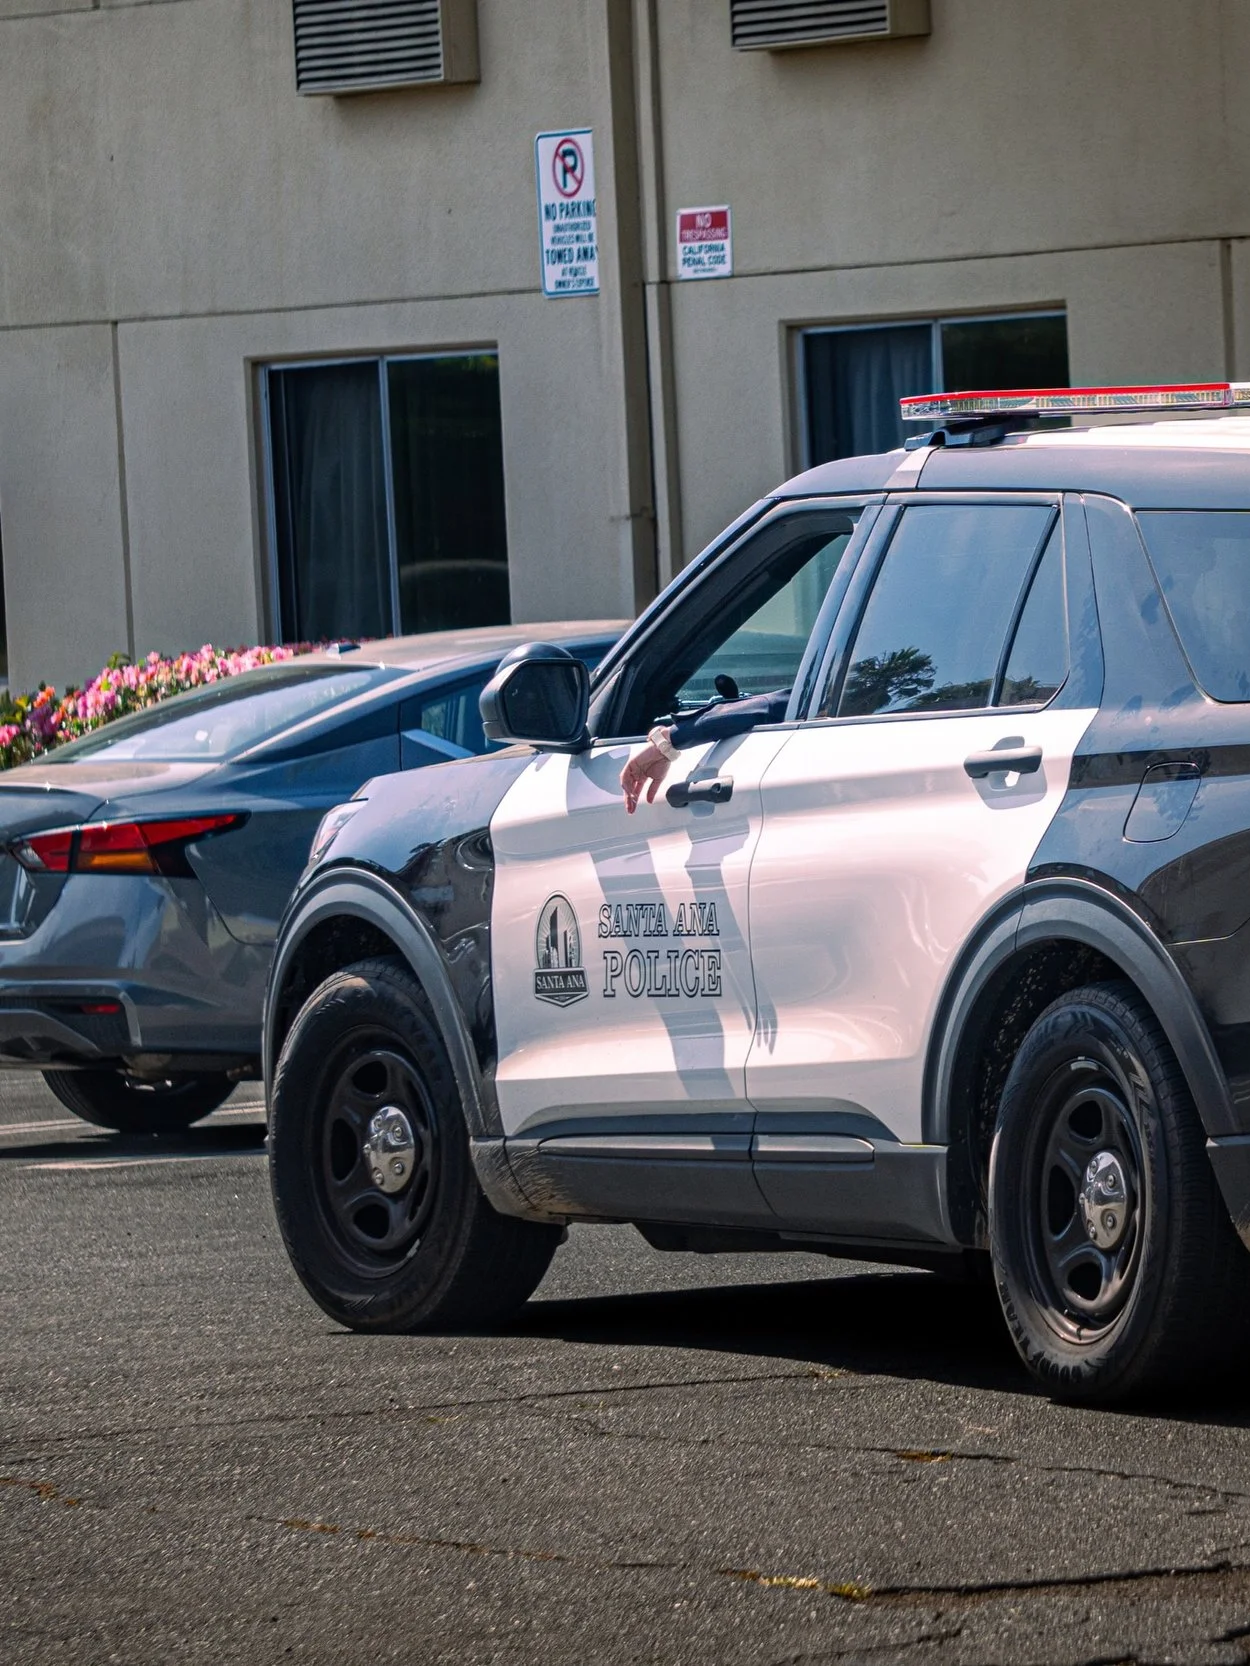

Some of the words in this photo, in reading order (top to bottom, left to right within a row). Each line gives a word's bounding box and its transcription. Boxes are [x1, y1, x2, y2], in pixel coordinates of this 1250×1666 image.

[544, 203, 556, 221] NO
[696, 213, 712, 228] NO
[682, 227, 727, 241] TRESPASSING
[545, 247, 574, 266] TOWED
[682, 243, 725, 256] CALIFORNIA
[682, 256, 705, 268] PENAL
[707, 254, 726, 265] CODE
[598, 903, 668, 938] SANTA
[672, 902, 720, 937] ANA
[603, 949, 722, 998] POLICE
[536, 976, 565, 989] SANTA
[566, 975, 585, 988] ANA
